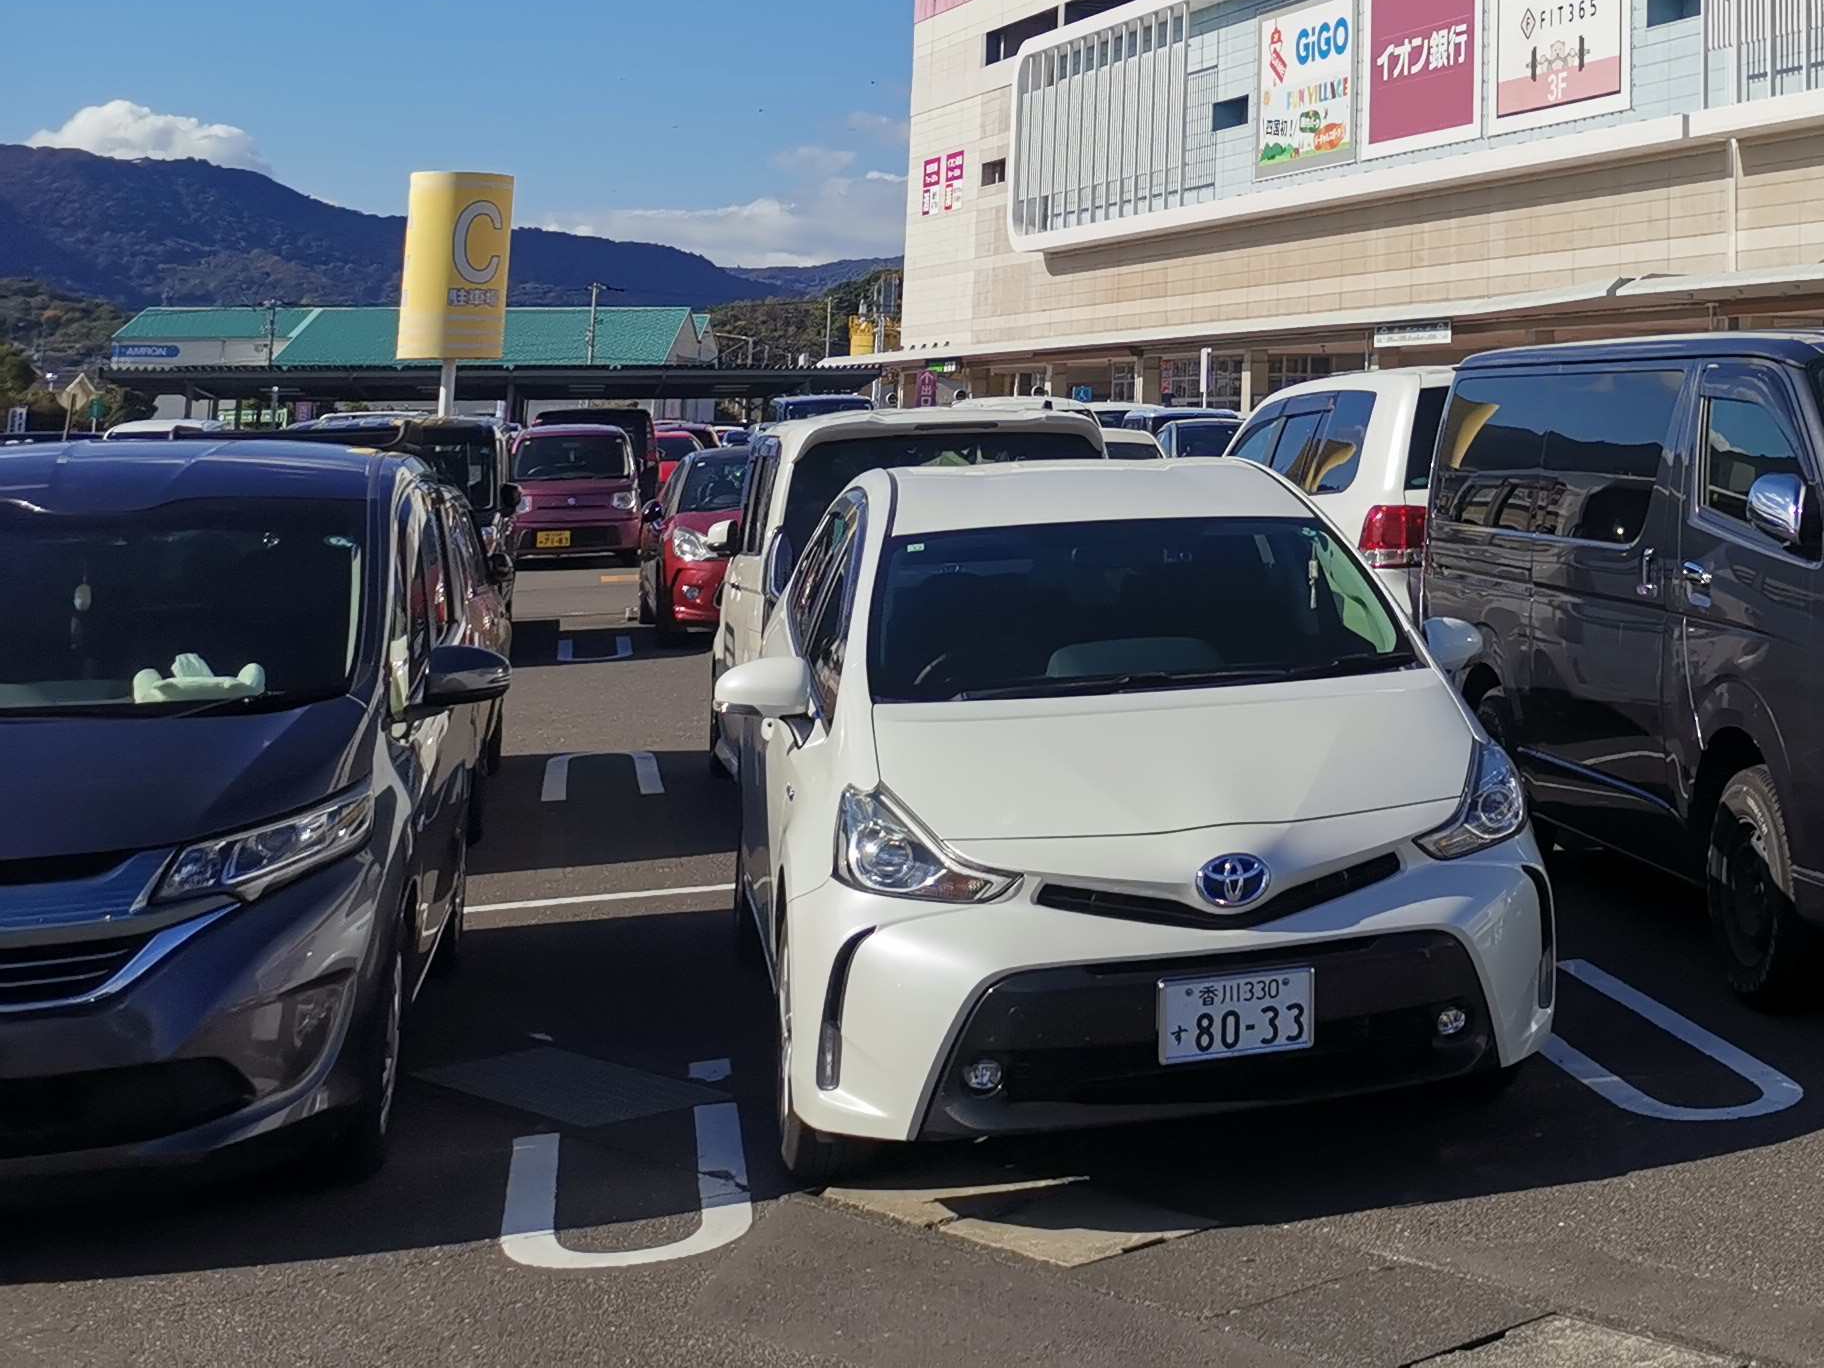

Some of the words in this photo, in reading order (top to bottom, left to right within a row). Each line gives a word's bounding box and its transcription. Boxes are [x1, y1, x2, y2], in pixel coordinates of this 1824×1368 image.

[1295, 17, 1349, 65] GiGO
[1376, 23, 1468, 82] イオン銀行
[1286, 88, 1305, 110] FUN
[1307, 76, 1349, 106] VILLAGE
[1547, 71, 1568, 102] 3F
[452, 199, 503, 285] C
[448, 288, 500, 307] 駐車場
[920, 384, 933, 406] 出口
[1199, 978, 1280, 1007] 香川330
[1195, 1002, 1305, 1052] 80-33
